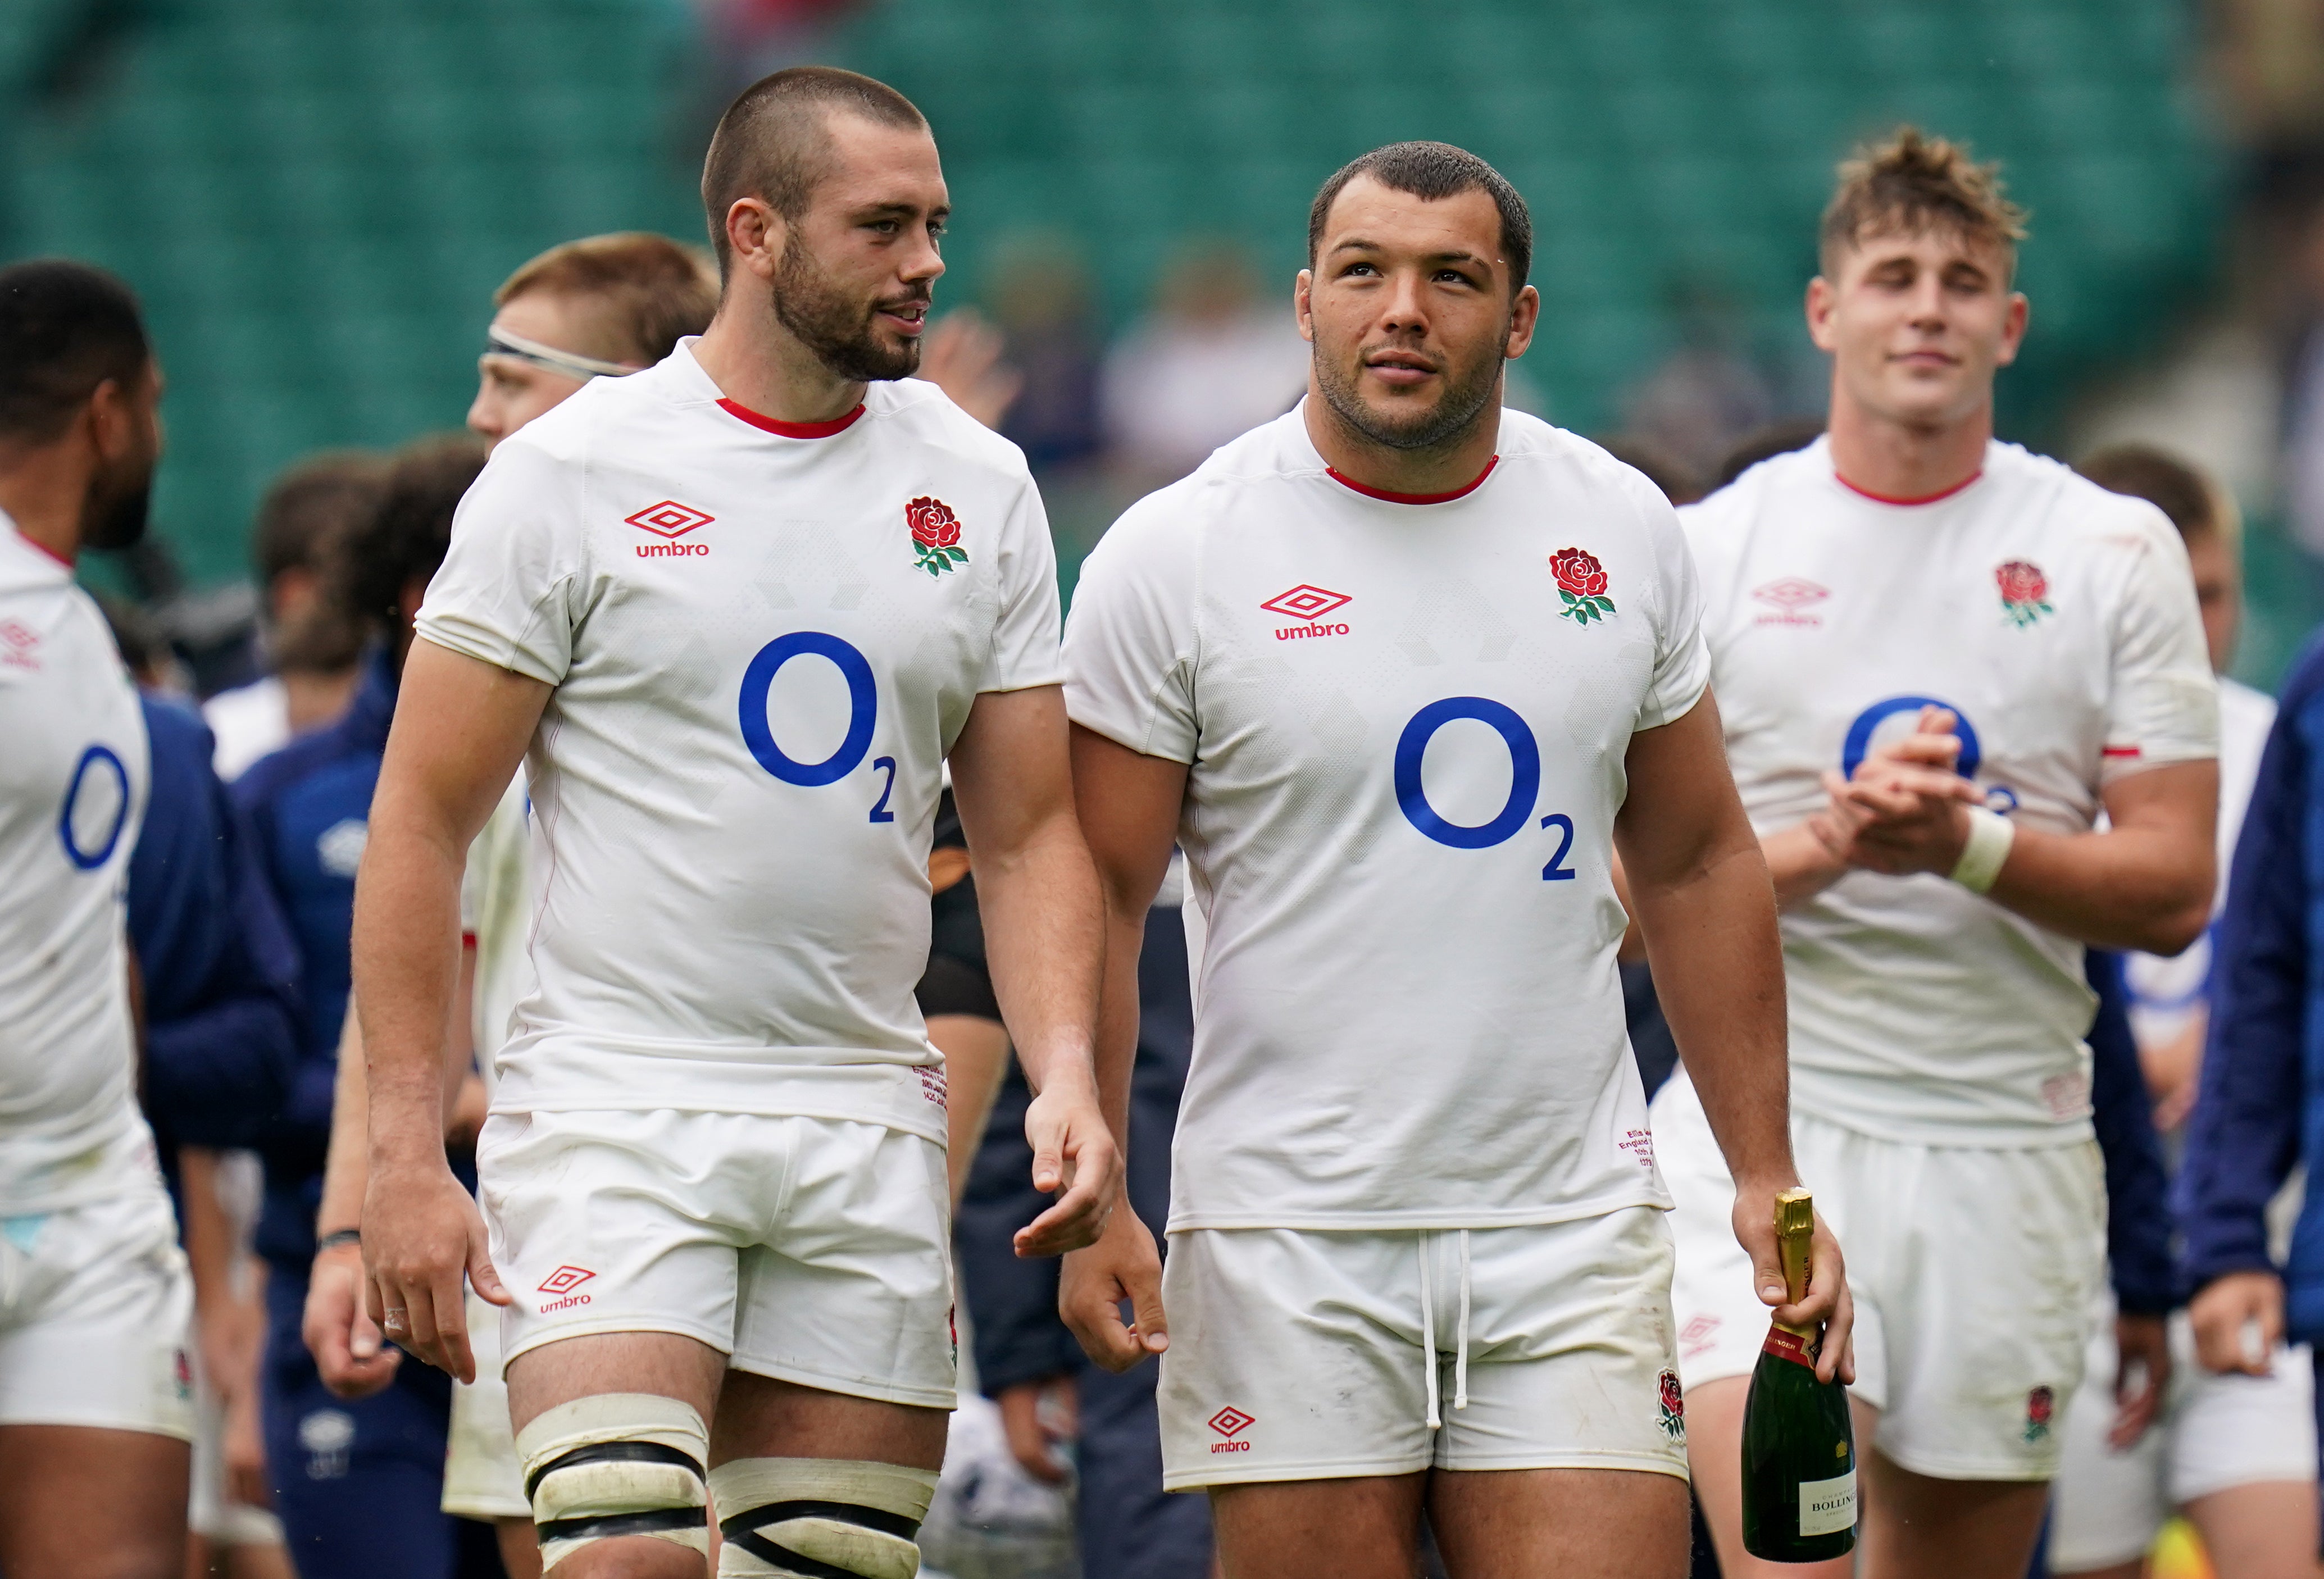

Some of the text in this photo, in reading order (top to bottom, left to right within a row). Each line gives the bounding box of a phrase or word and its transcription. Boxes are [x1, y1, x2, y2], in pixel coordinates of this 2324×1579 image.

[636, 540, 710, 558] umbro
[1275, 621, 1350, 641] umbro
[1627, 1129, 1644, 1138] Ellis
[1618, 1138, 1649, 1149] England
[540, 1295, 591, 1313] umbro
[1211, 1439, 1250, 1454] umbro
